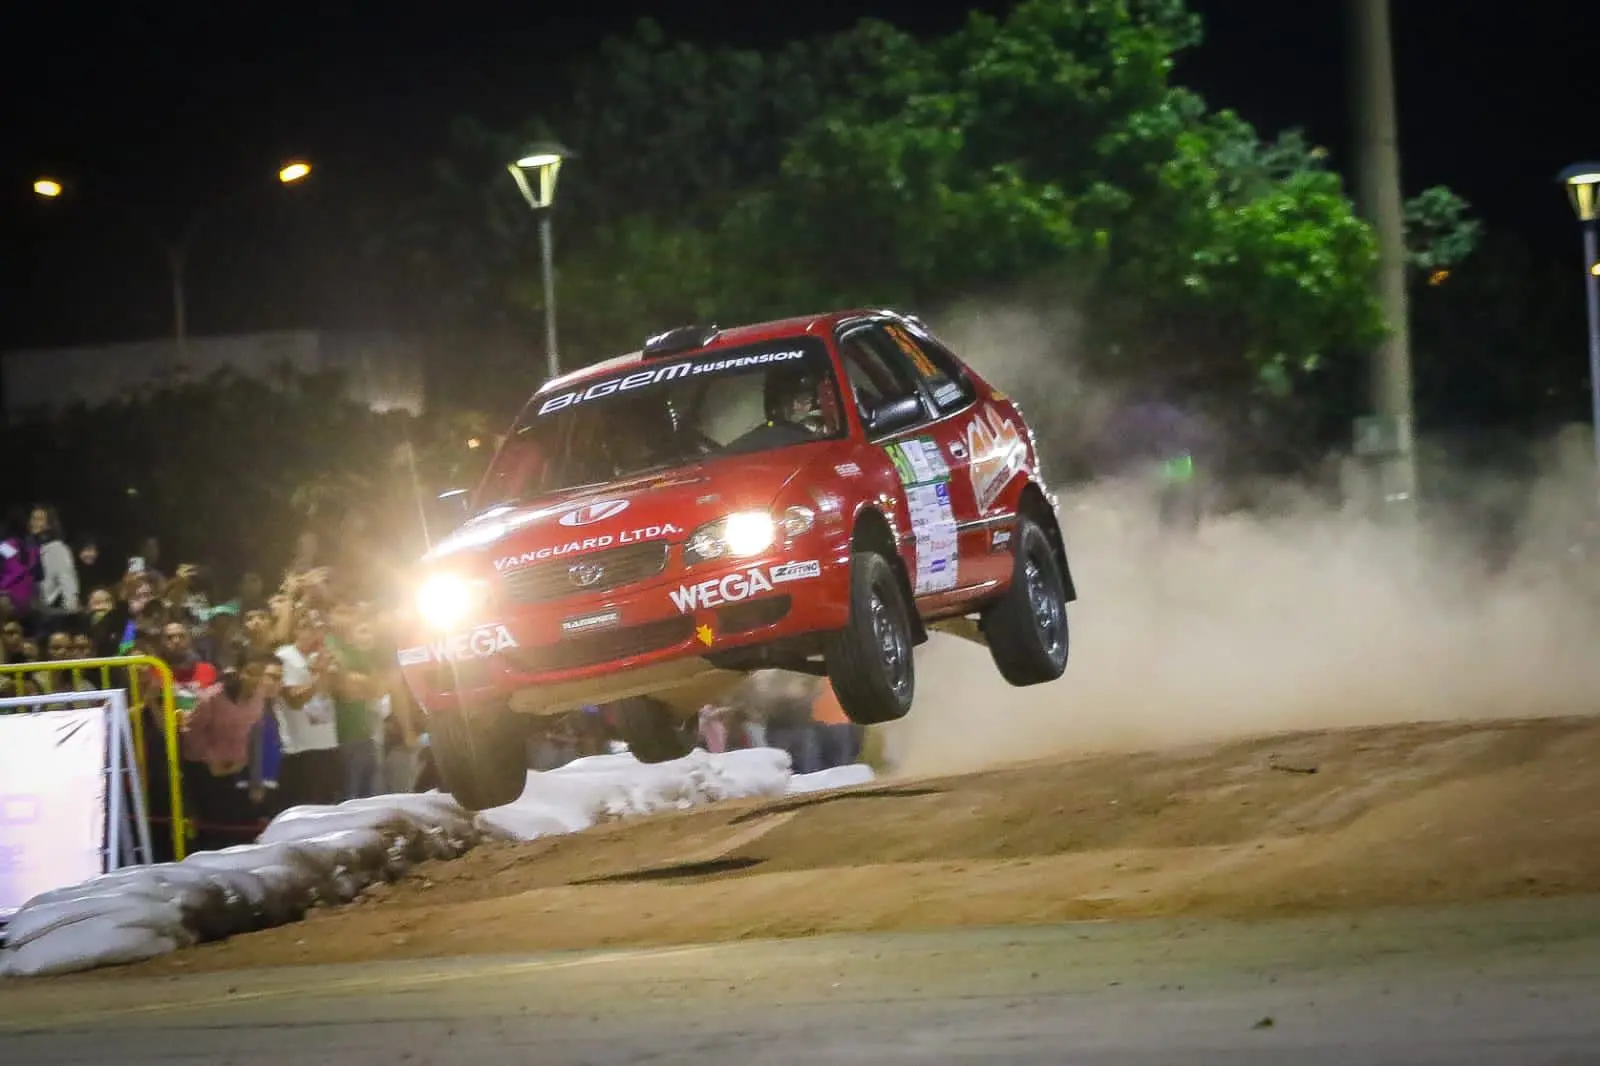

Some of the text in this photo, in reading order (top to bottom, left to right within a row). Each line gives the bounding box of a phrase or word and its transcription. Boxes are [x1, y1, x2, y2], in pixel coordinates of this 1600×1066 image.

[692, 350, 805, 374] SUSPENSION
[493, 523, 684, 572] VANGUARD LTDA.
[668, 568, 774, 614] WEGA
[428, 624, 520, 663] WEGA
